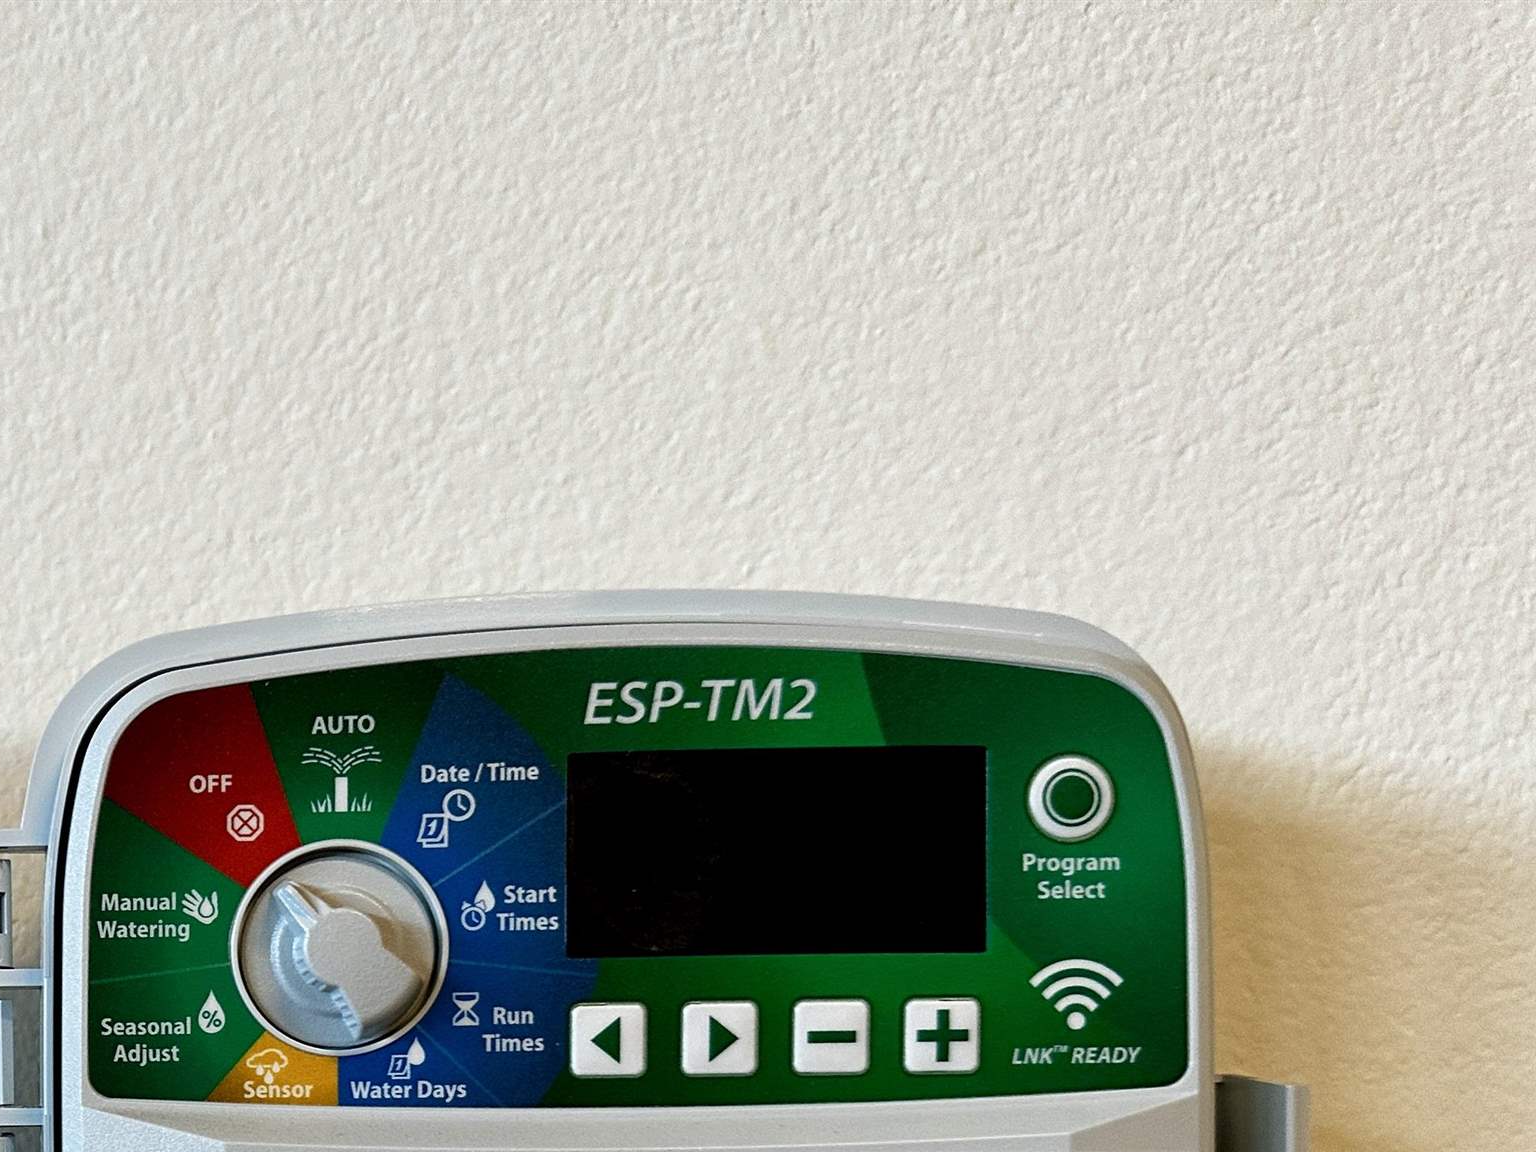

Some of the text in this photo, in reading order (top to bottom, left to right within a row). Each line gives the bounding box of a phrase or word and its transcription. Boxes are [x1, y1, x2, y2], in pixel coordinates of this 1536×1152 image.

[584, 680, 817, 726] ESP-TM2
[311, 715, 376, 735] AUTO
[421, 763, 540, 784] Date Time
[189, 774, 233, 794] OFF
[1022, 854, 1121, 877] Program
[504, 884, 558, 905] Start
[1037, 881, 1106, 900] Select
[101, 892, 177, 912] Manual
[97, 921, 191, 943] Watering
[496, 912, 559, 932] Times
[493, 1007, 535, 1026] Run
[100, 1017, 192, 1038] Seasonal
[482, 1034, 545, 1053] Times
[113, 1045, 180, 1066] Adjust
[1071, 1046, 1142, 1065] READY
[243, 1082, 313, 1100] Sensor
[350, 1082, 412, 1100] Water
